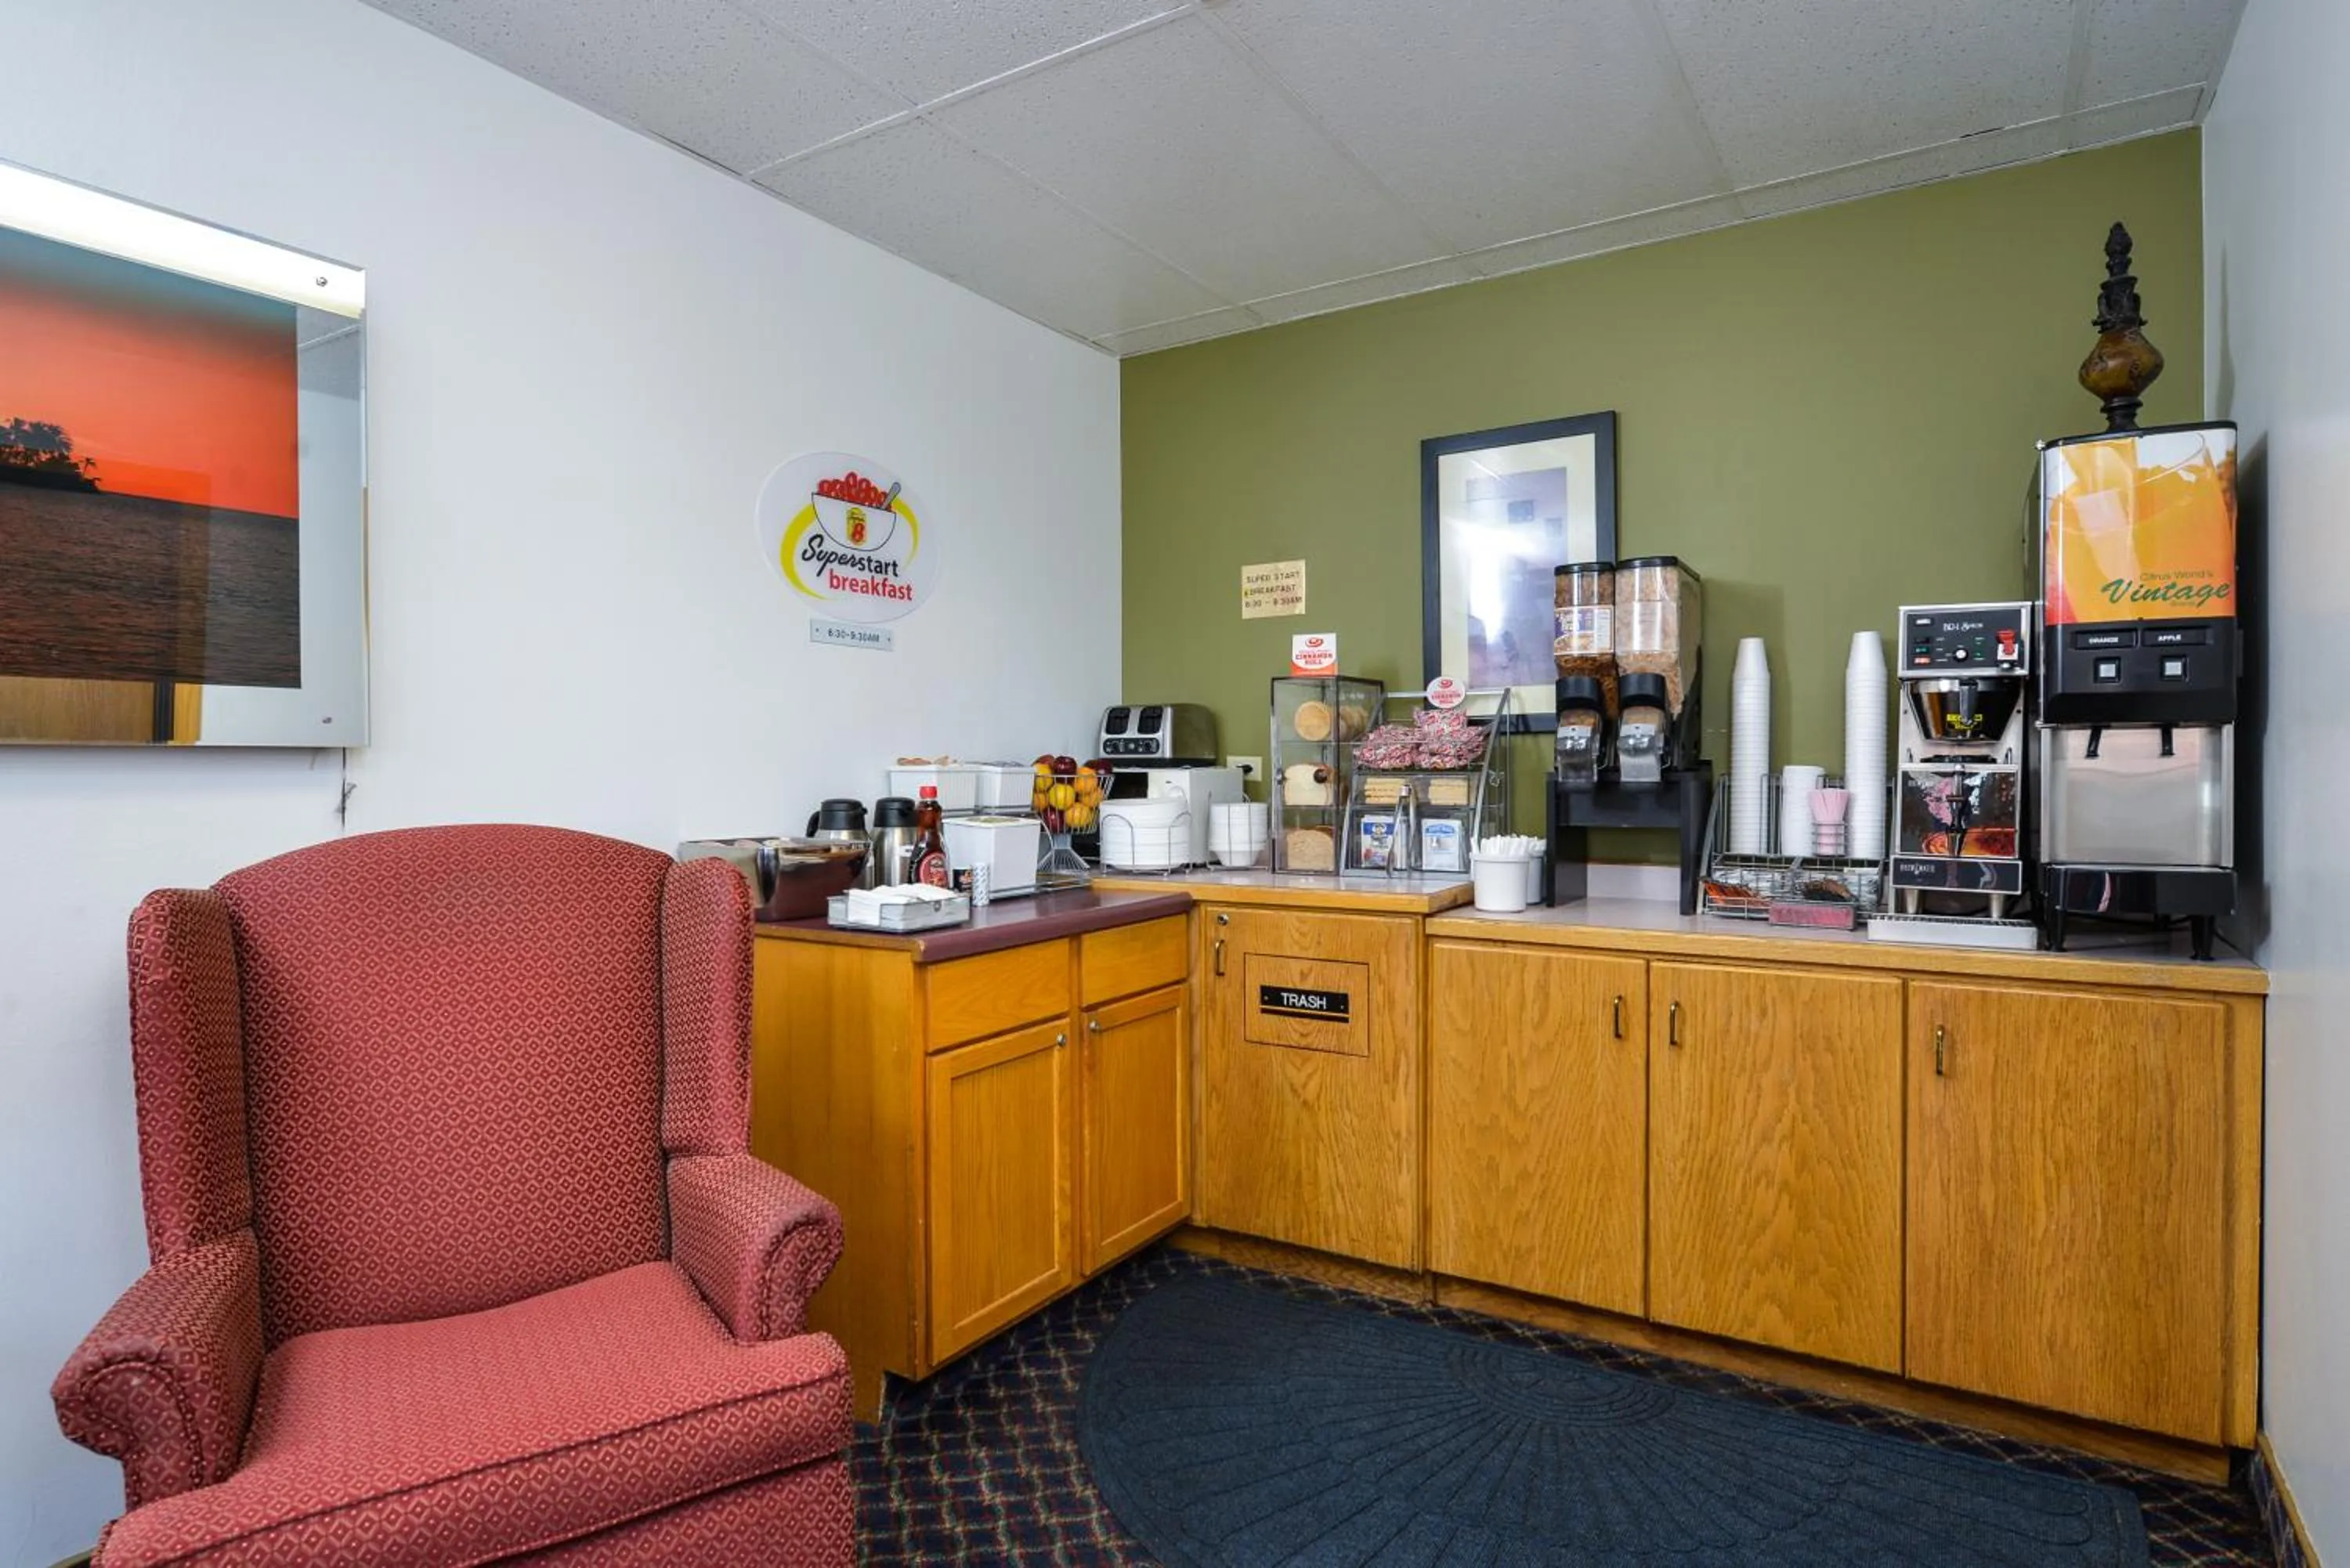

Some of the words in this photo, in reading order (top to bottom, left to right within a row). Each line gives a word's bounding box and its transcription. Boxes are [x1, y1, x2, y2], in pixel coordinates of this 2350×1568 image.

[801, 533, 898, 577] Superstart
[828, 568, 913, 602] breakfast
[2101, 578, 2231, 609] Vintage
[1281, 992, 1327, 1010] TRASH
